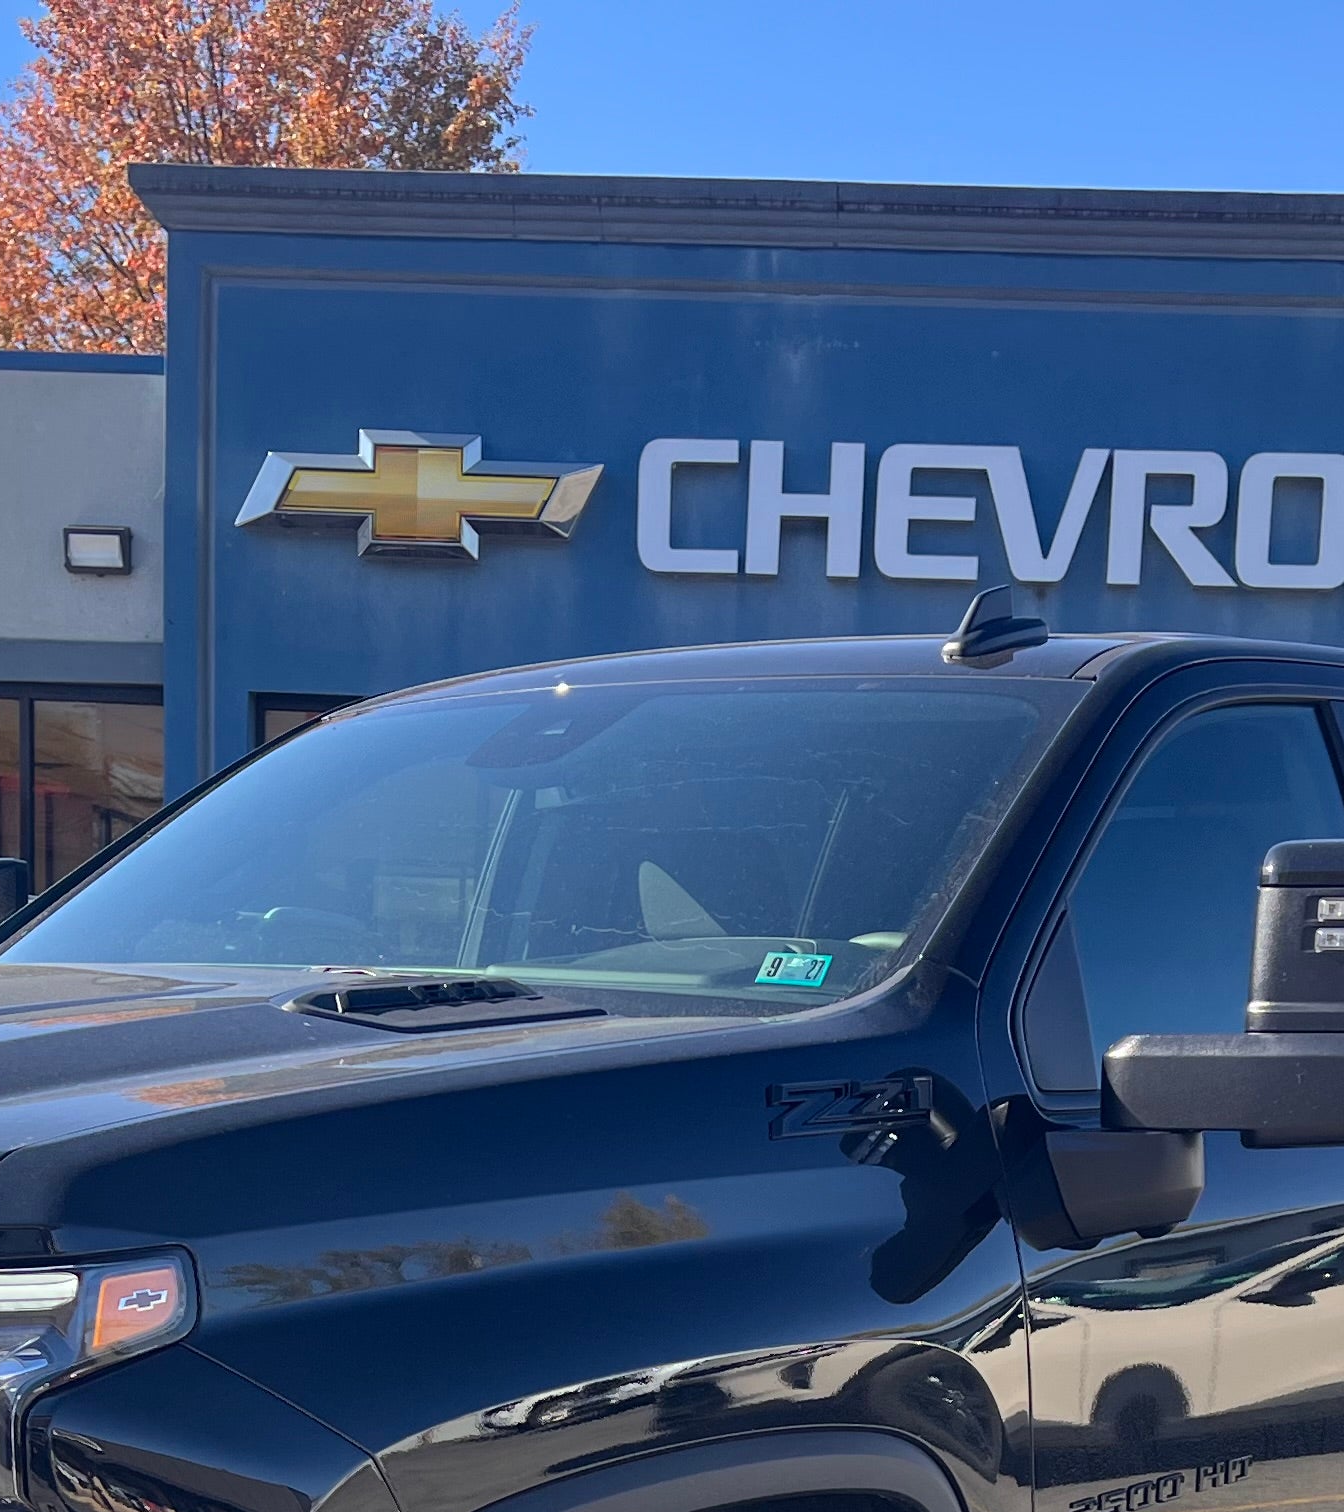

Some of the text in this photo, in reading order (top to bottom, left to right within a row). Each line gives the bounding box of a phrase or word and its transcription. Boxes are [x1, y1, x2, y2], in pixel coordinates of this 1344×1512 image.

[766, 956, 784, 978] 9
[804, 959, 826, 981] 27
[765, 1076, 933, 1141] Z71
[1195, 1454, 1254, 1493] HD
